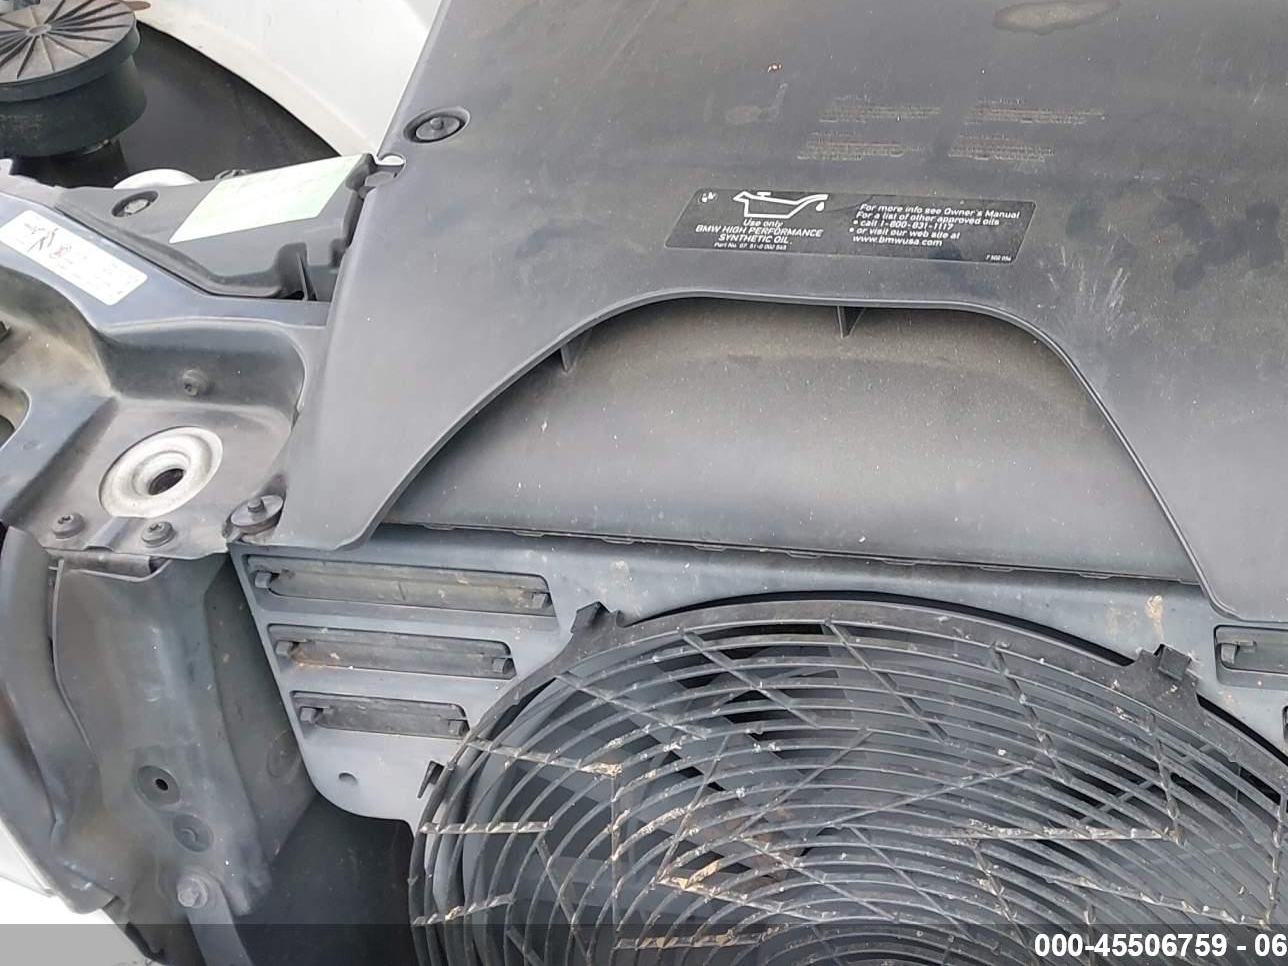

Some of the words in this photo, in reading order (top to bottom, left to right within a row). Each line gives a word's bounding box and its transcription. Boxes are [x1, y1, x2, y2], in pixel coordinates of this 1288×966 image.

[860, 203, 876, 212] For
[878, 205, 903, 213] more
[906, 206, 922, 214] info
[944, 208, 982, 217] Owner's
[985, 210, 1020, 218] Manual
[743, 218, 761, 227] Use
[763, 220, 784, 228] only
[856, 211, 873, 219] For
[874, 212, 880, 220] a
[882, 212, 898, 220] list
[898, 213, 910, 221] of
[910, 214, 936, 222] other
[936, 216, 981, 225] approved
[982, 218, 1000, 226] oils
[695, 224, 722, 233] BMW
[722, 225, 747, 234] HIGH
[748, 226, 824, 237] PERFORMANCE
[869, 227, 889, 235] visit
[909, 230, 929, 238] web
[950, 232, 961, 240] at
[718, 233, 773, 243] SYNTHETIC
[852, 236, 943, 246] www.bmwusa.com
